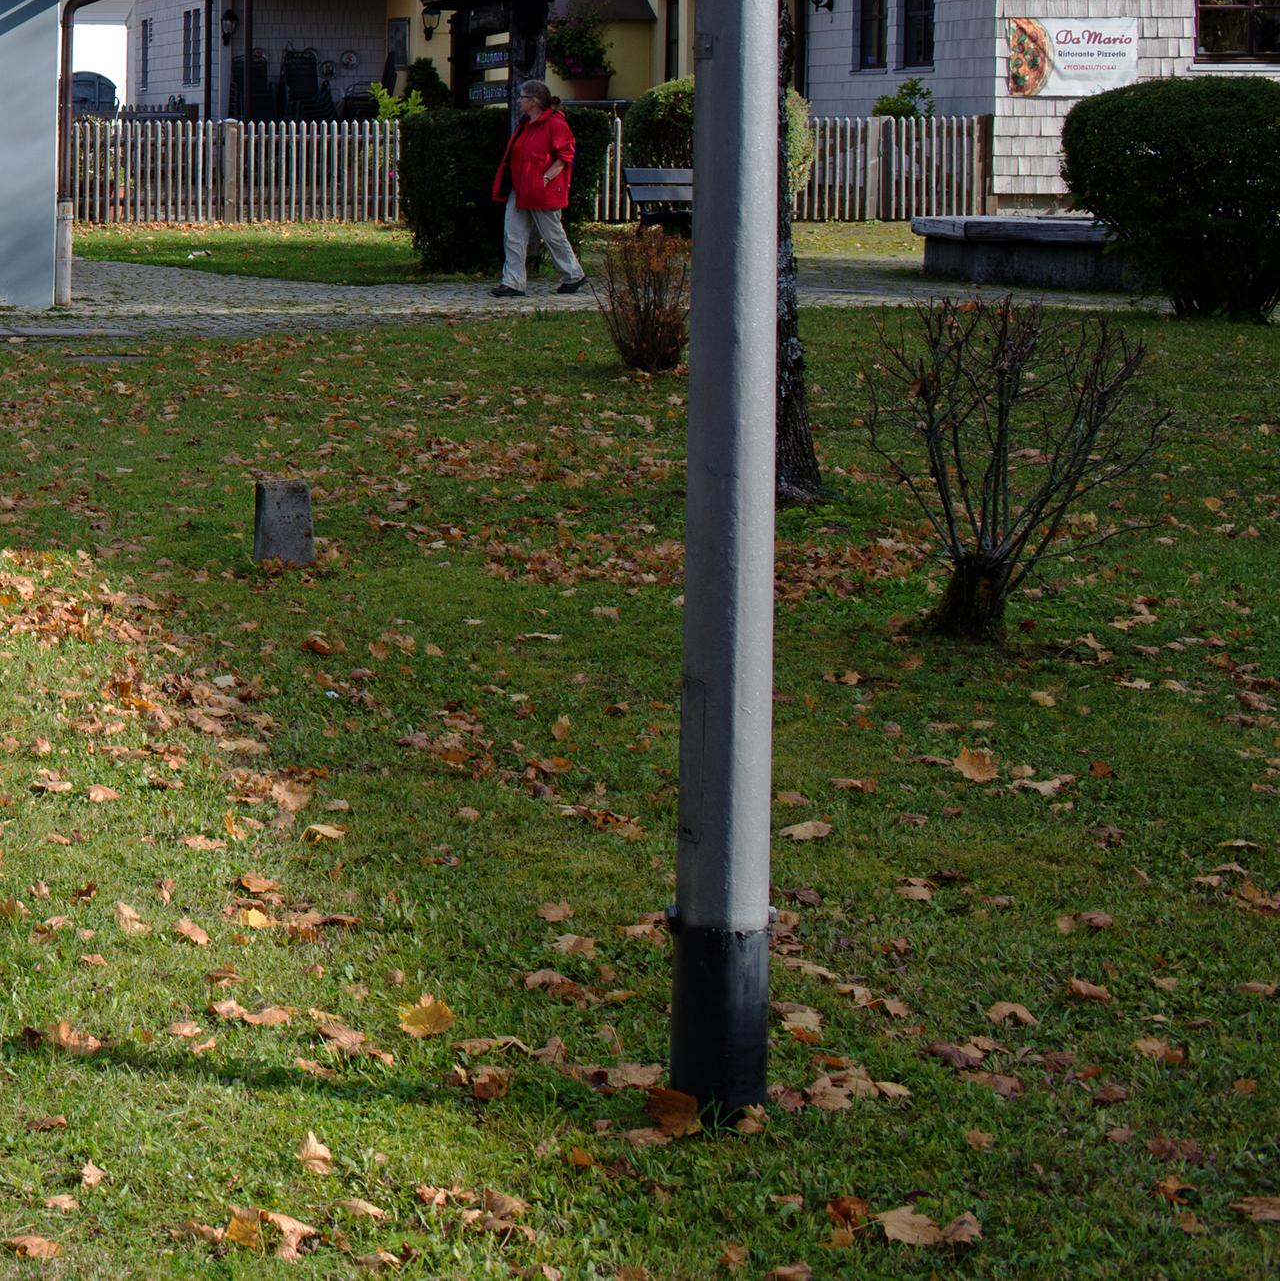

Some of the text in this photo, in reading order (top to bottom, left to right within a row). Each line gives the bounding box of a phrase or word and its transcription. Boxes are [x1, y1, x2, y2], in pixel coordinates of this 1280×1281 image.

[1055, 29, 1133, 45] Da Mario
[1058, 50, 1127, 58] Ristorante Pizzeria
